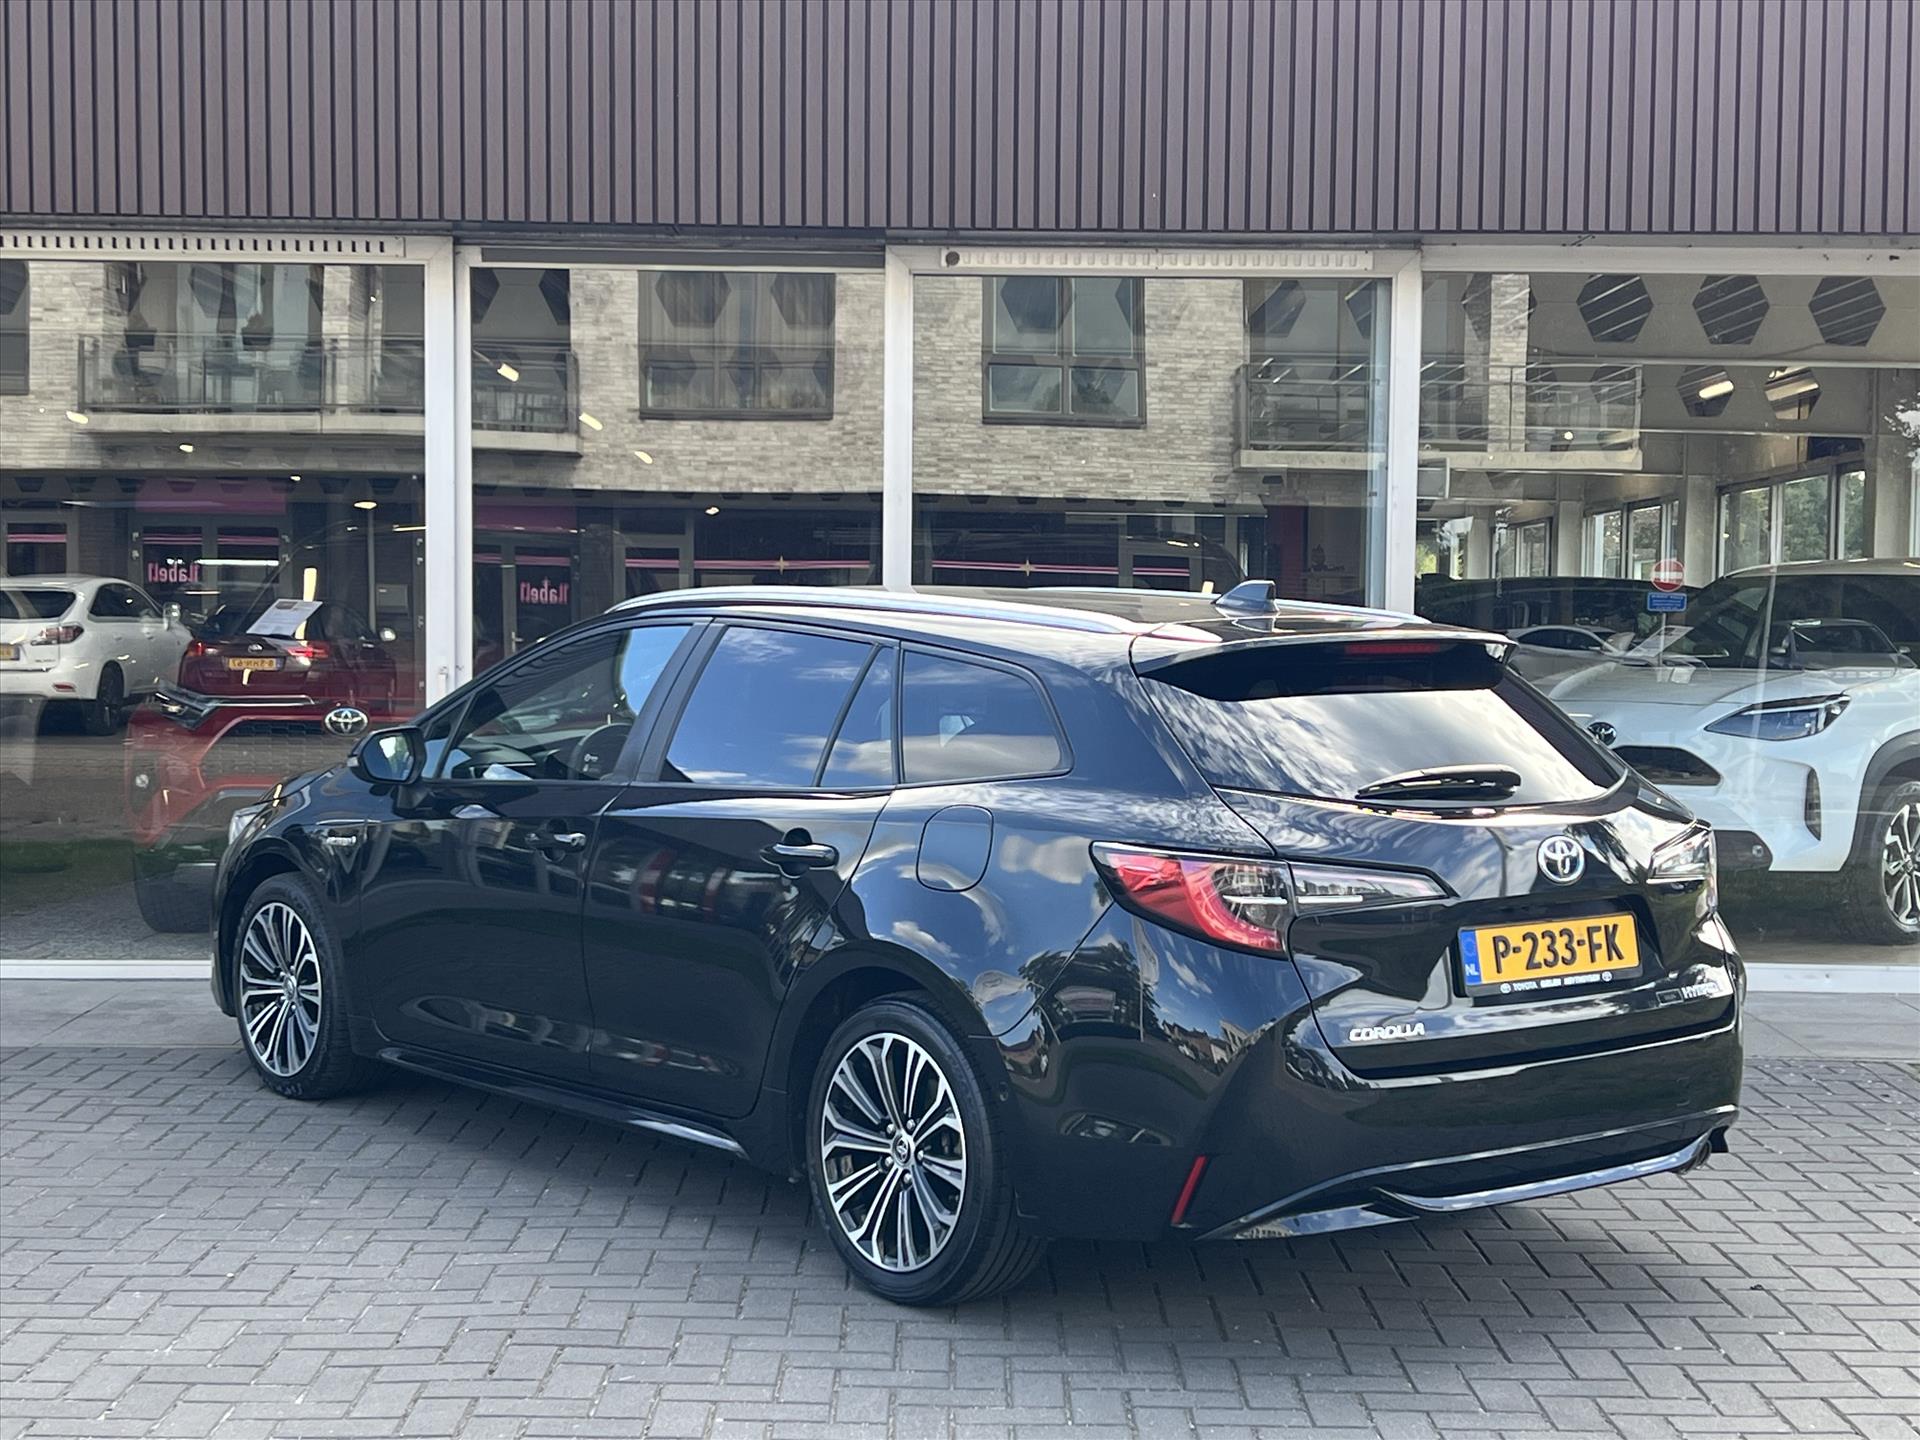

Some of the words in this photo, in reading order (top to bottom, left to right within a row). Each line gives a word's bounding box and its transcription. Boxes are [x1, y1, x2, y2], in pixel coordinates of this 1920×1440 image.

[1492, 924, 1624, 973] P-233-FK
[1465, 964, 1480, 977] NL
[1349, 1022, 1425, 1041] COROLLA
